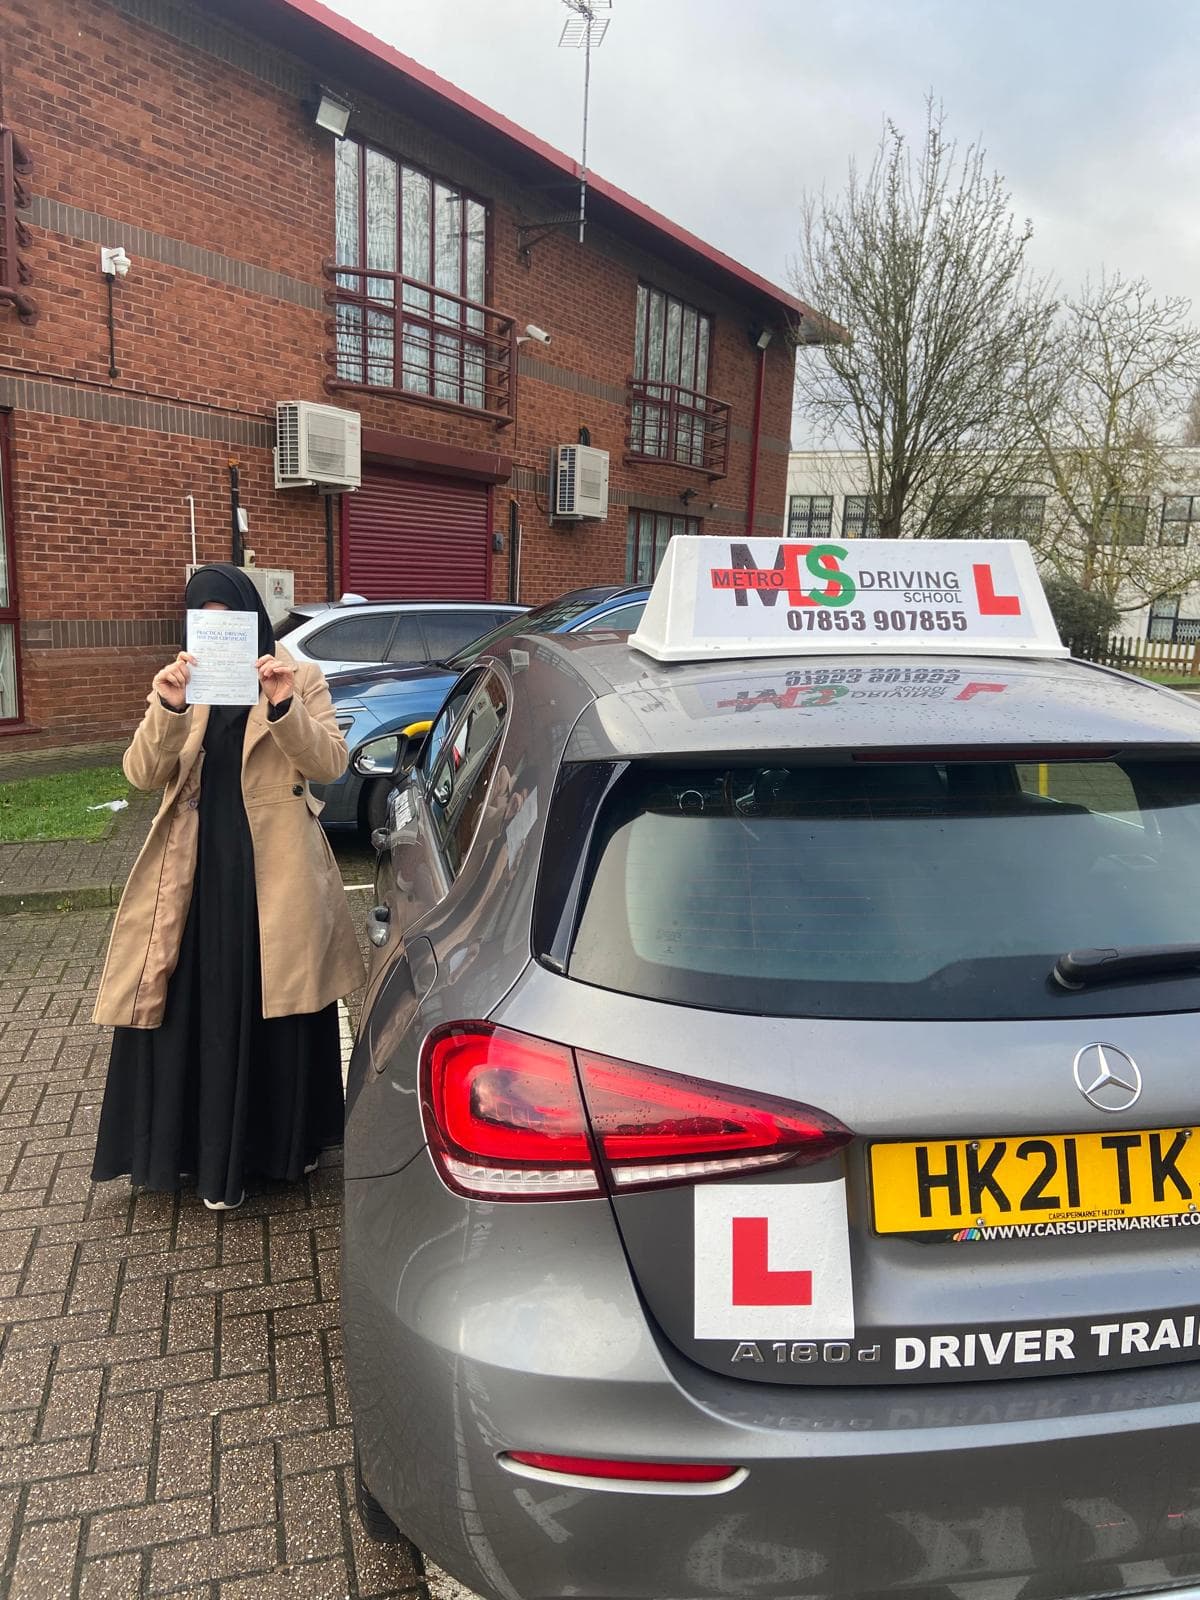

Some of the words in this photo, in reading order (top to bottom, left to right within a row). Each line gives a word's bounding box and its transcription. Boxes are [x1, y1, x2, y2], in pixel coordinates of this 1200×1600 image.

[713, 570, 785, 587] METRO
[858, 570, 960, 590] DRIVING
[972, 563, 1022, 616] L
[903, 591, 963, 604] SCHOOL
[786, 609, 867, 632] 07853
[873, 609, 968, 632] 907855
[915, 1138, 1081, 1218] HK21
[1101, 1131, 1200, 1205] TK
[981, 1212, 1200, 1241] WWW.CARSUPERMARKET.CO
[1048, 1209, 1101, 1220] CARSUPERMARKET
[732, 1216, 813, 1306] L
[895, 1328, 1076, 1371] DRIVER
[1090, 1315, 1200, 1357] TRAI
